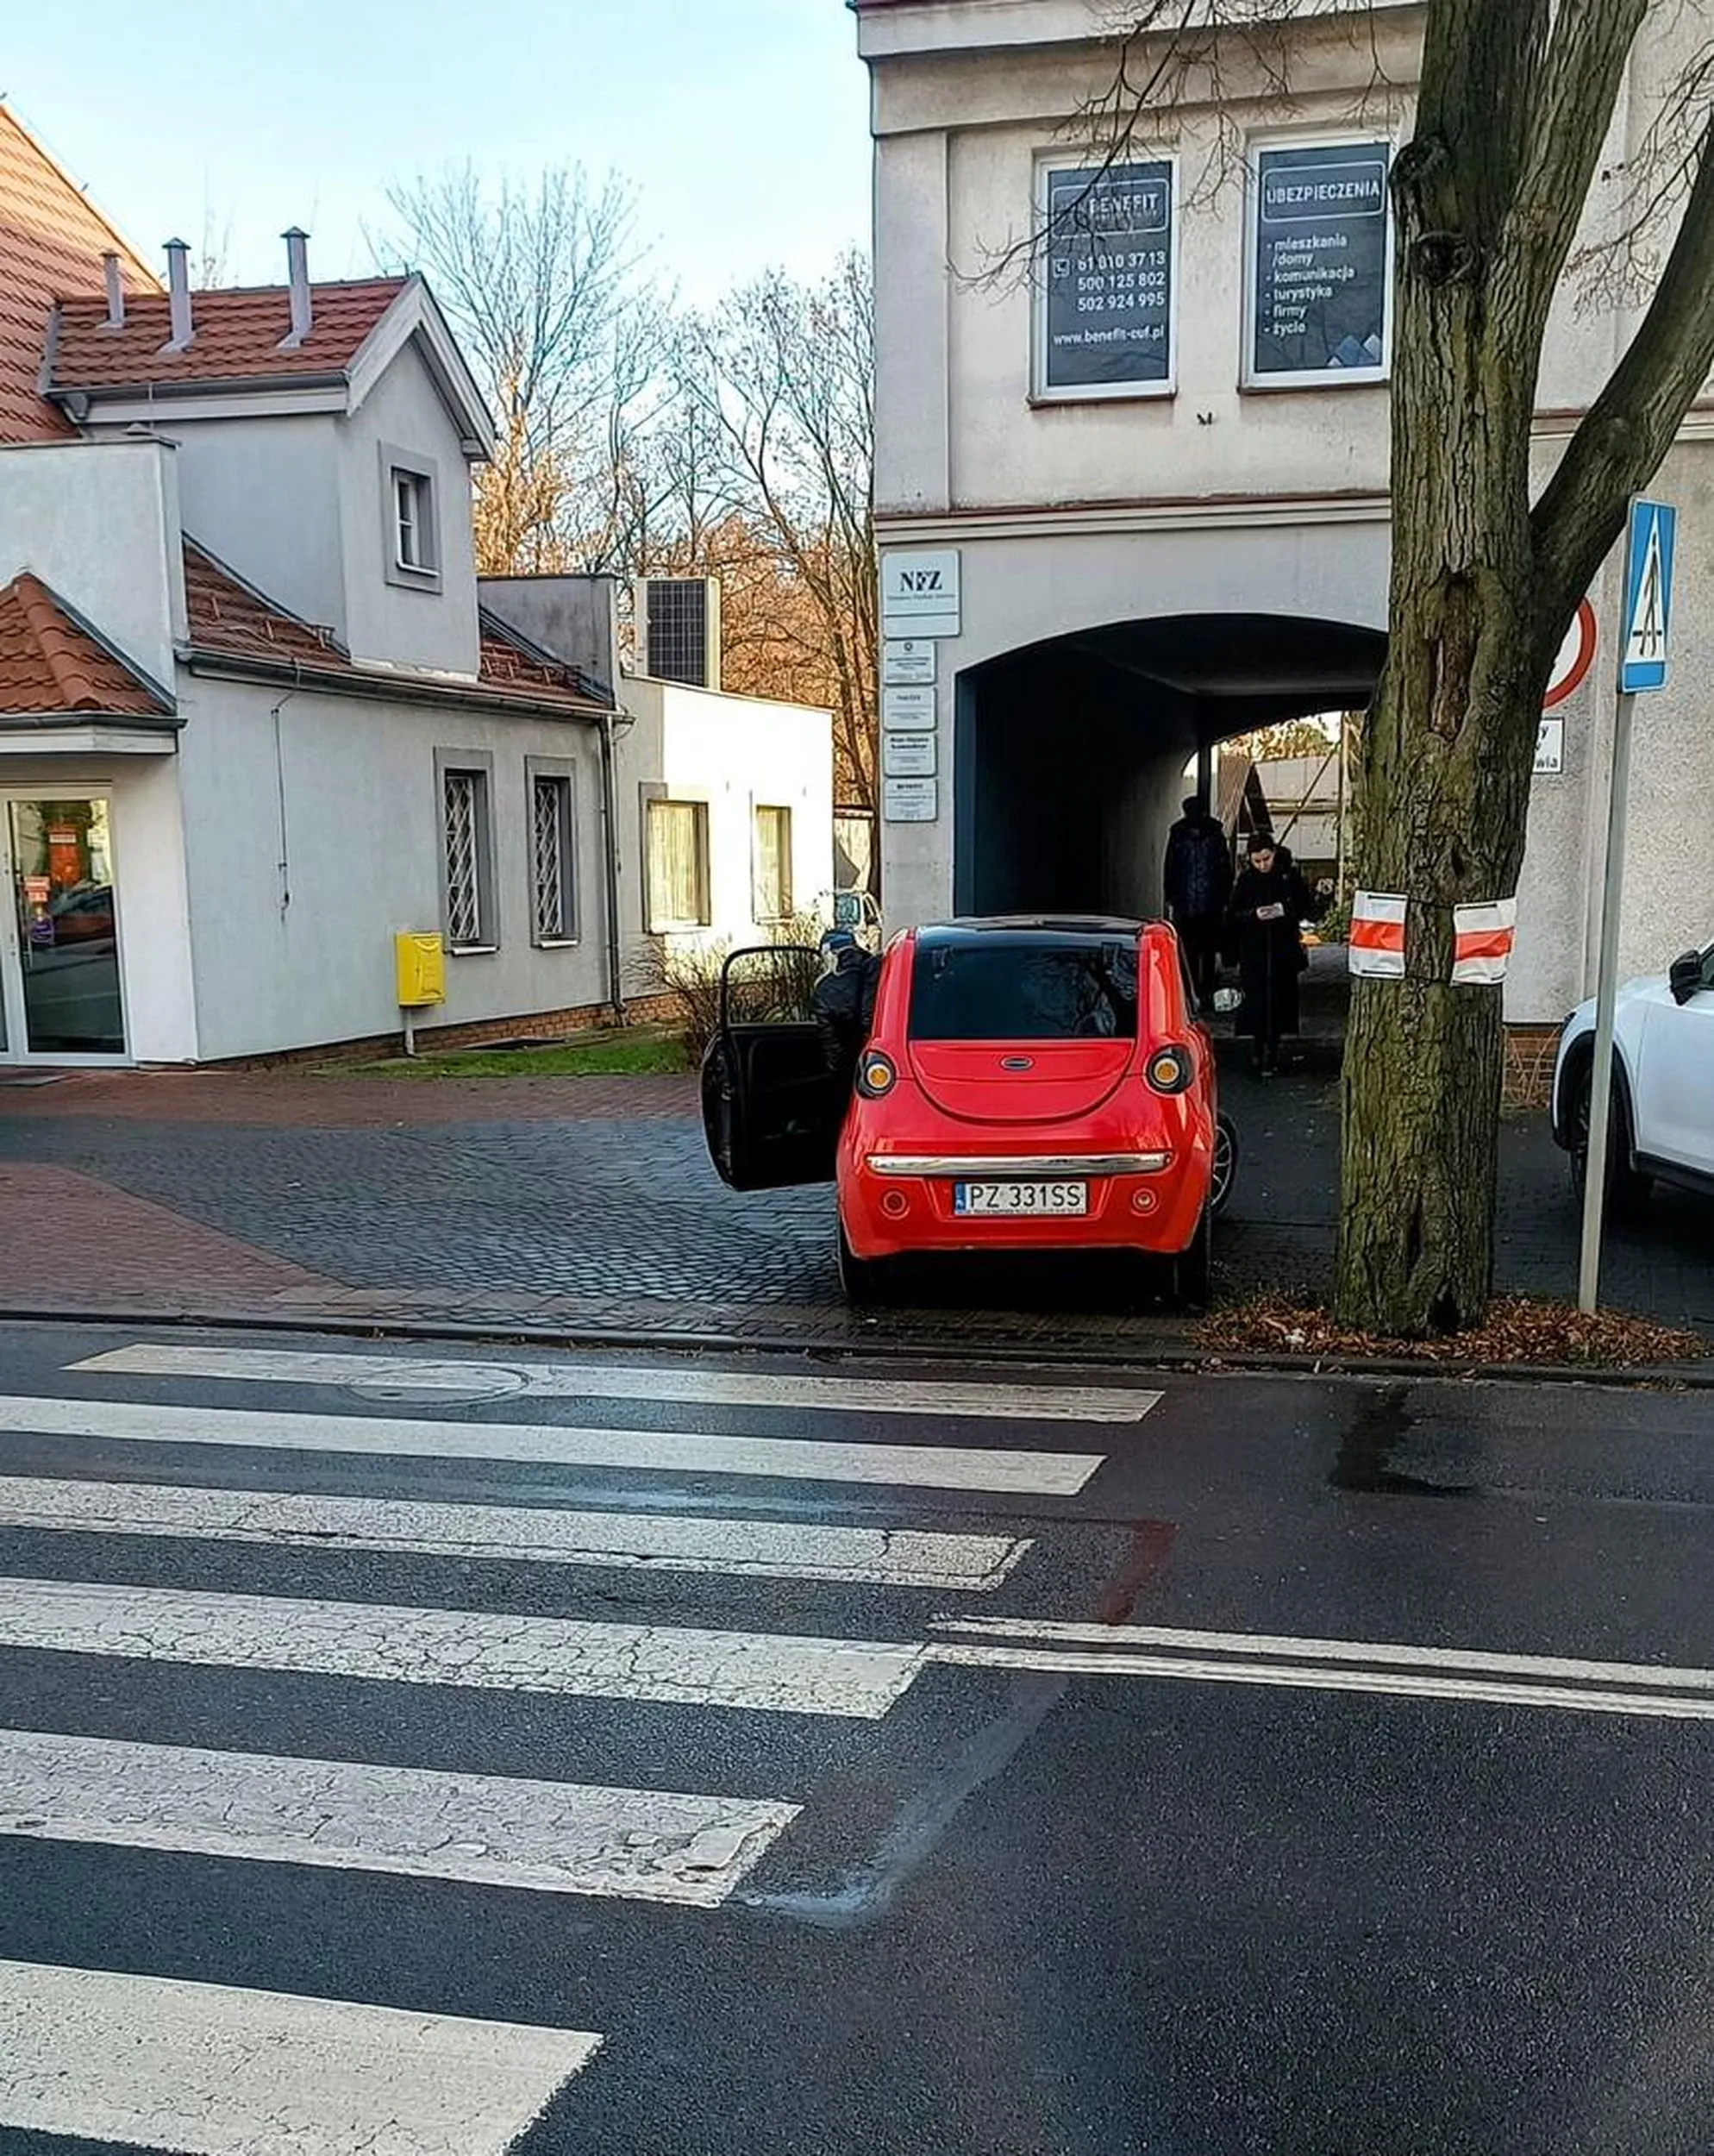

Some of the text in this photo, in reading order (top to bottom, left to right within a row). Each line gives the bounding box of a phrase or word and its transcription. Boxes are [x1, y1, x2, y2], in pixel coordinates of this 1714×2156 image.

[1266, 180, 1380, 204] UBEZPIECZENIA
[1274, 233, 1348, 251] mieszkania
[1078, 271, 1166, 291] 500 125 802
[1274, 265, 1356, 283] komunikacja
[1078, 291, 1165, 311] 502 924 995
[1273, 285, 1334, 303] turystyka
[1273, 304, 1309, 319] firmy
[900, 570, 943, 592] NFZ
[970, 1185, 1000, 1208] PZ
[1008, 1184, 1081, 1207] 331SS
